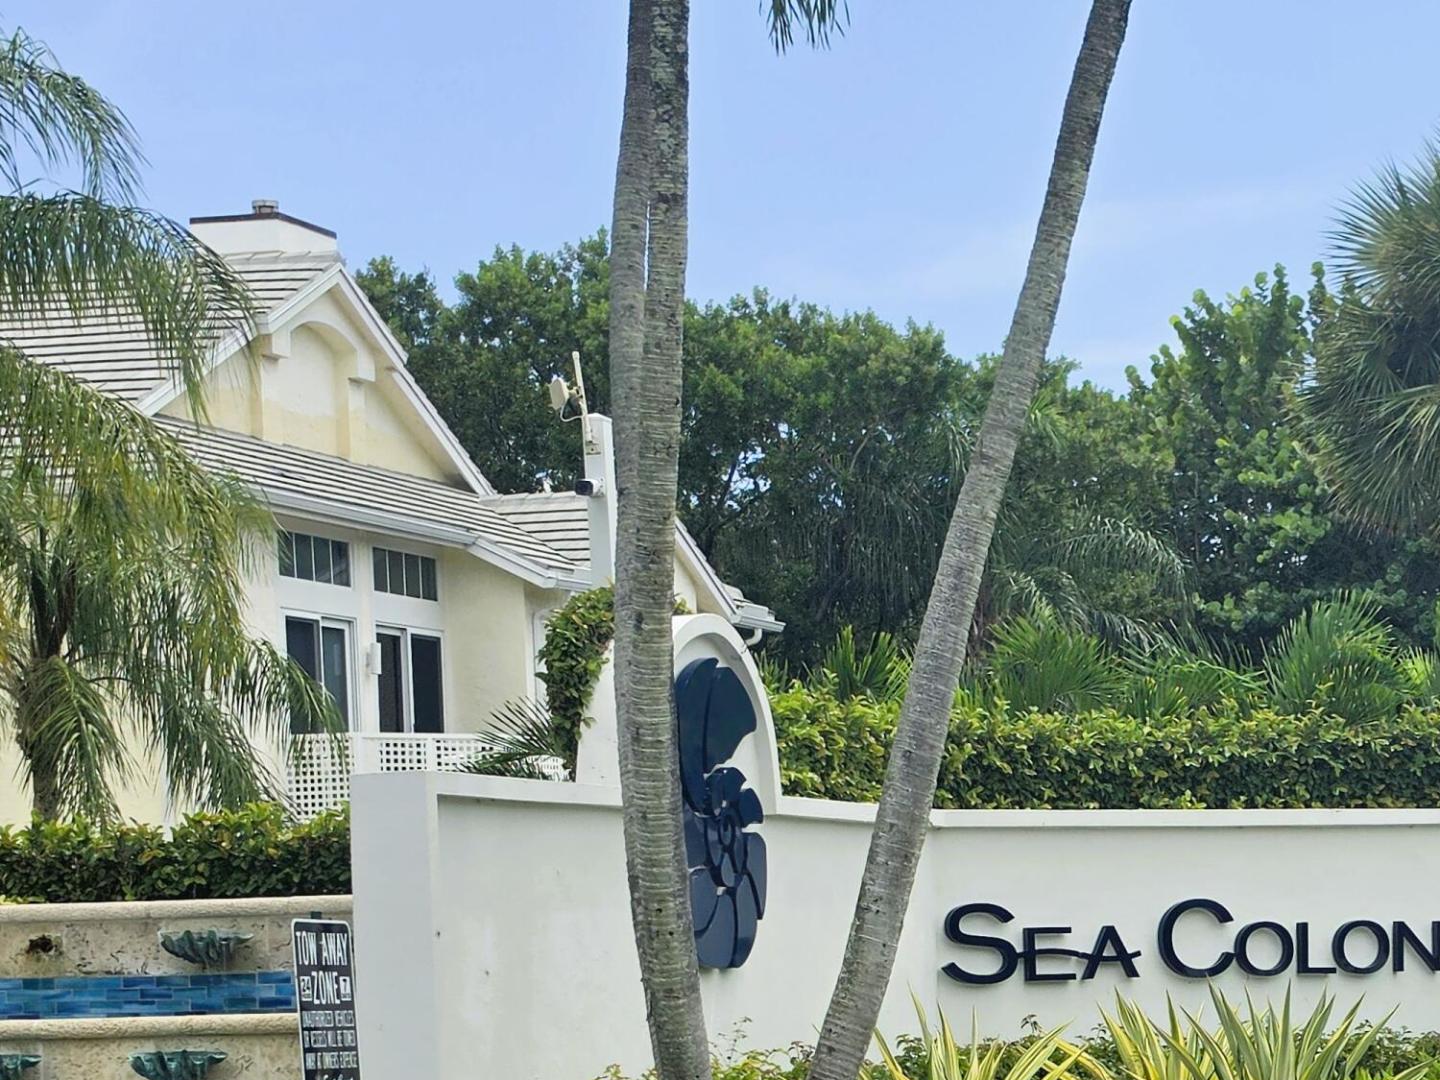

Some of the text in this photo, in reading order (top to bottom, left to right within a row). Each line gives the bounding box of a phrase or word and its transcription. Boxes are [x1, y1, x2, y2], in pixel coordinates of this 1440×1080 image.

[296, 931, 348, 966] TOW AWAY
[941, 902, 1142, 985] SEA
[311, 970, 341, 1005] ZONE
